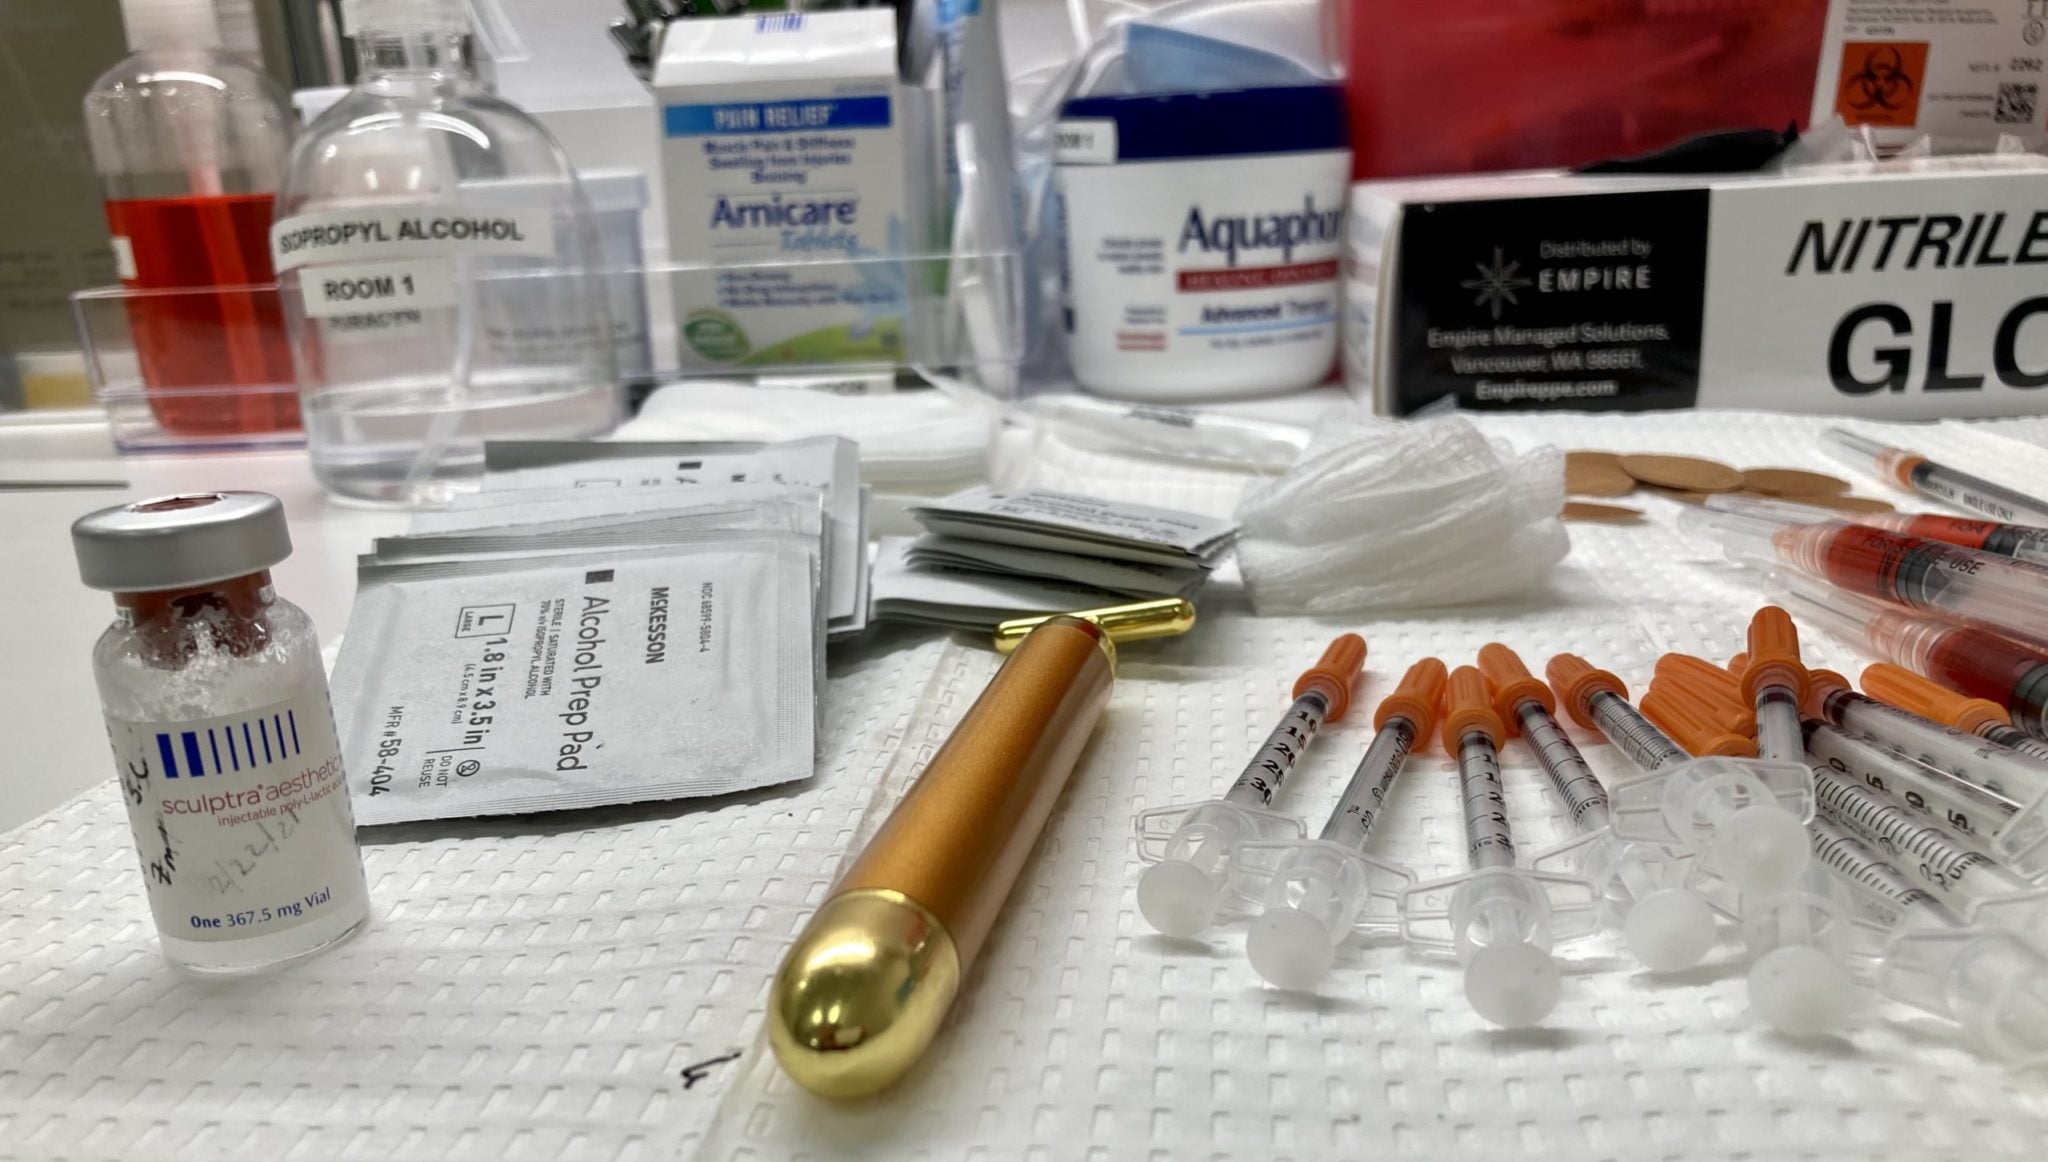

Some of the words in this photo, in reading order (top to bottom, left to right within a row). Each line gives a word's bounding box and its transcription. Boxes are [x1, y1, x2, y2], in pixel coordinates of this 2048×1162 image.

[714, 108, 760, 130] PAIN
[711, 194, 857, 229] Arnicare
[398, 217, 526, 241] ALCOHOL
[1539, 240, 1628, 258] Distributed
[1632, 238, 1650, 258] by
[1785, 209, 2048, 276] NITRILE
[324, 276, 395, 301] ROOM
[402, 274, 415, 295] 1
[1539, 265, 1651, 292] EMPIRE
[1428, 327, 1491, 350] Empire
[1494, 324, 1577, 348] Managed
[1551, 350, 1583, 370] WA
[1948, 558, 1986, 576] USE
[461, 611, 474, 632] LARGE
[478, 615, 504, 626] L
[550, 598, 565, 627] STERILE
[573, 596, 610, 672] Alcohol
[483, 638, 508, 662] 1.8
[544, 634, 560, 676] SATURATED
[479, 666, 504, 683] in
[524, 665, 541, 700] ALCOHOL
[540, 676, 553, 697] WITH
[475, 686, 494, 697] x
[558, 676, 601, 726] Prep
[385, 706, 404, 728] MFR
[469, 700, 496, 726] 3.5
[463, 729, 490, 744] in
[440, 755, 453, 767] DO
[556, 731, 594, 771] Pad
[1273, 742, 1295, 768] 20
[265, 754, 340, 802] aesthetic
[418, 758, 436, 788] REUSE
[436, 768, 450, 787] NOT
[1250, 777, 1272, 806] 30
[218, 804, 277, 828] injectable
[190, 915, 222, 929] One
[226, 906, 273, 928] 367.5
[277, 901, 303, 918] mg
[304, 886, 331, 909] Vial
